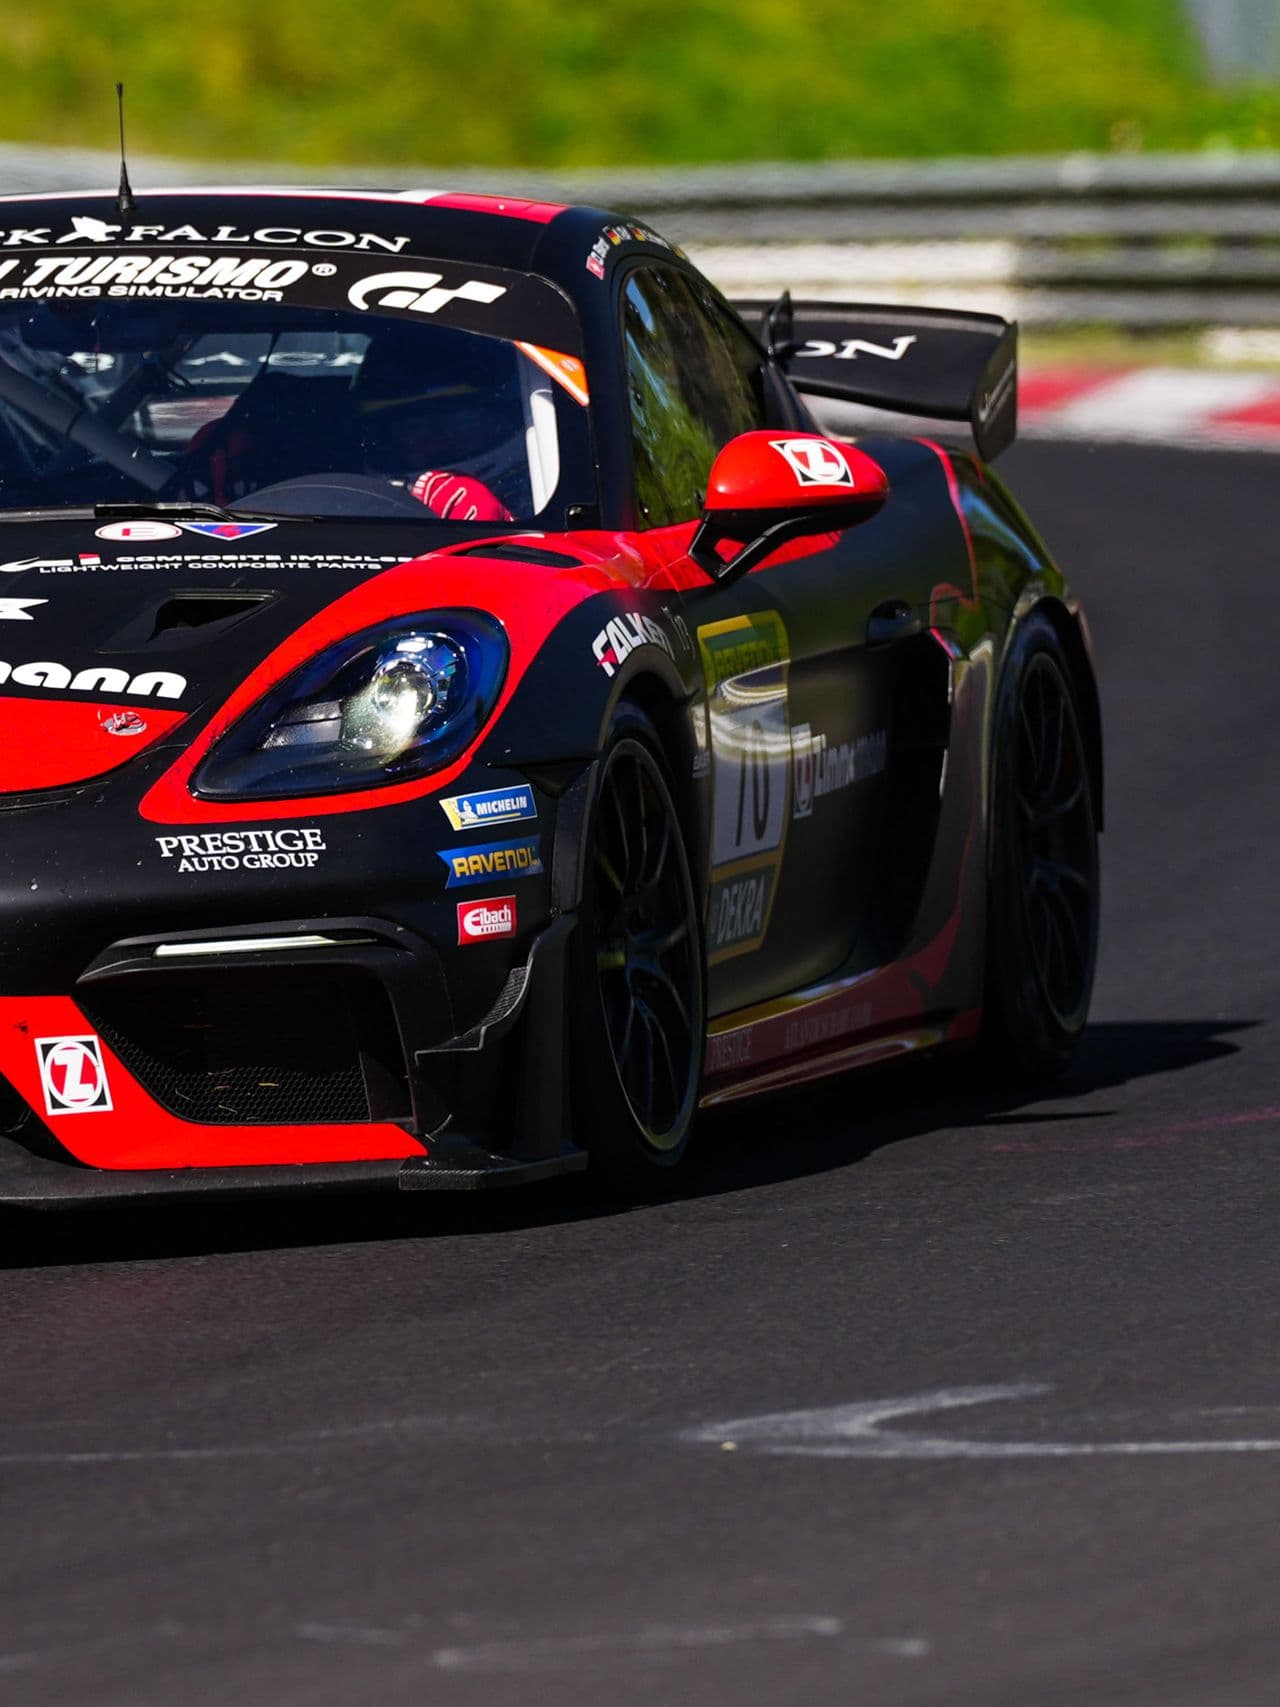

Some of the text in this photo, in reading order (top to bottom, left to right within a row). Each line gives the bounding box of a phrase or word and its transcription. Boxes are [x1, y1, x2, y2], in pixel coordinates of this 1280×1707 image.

[123, 224, 412, 253] FALCON
[107, 285, 284, 301] SIMULATOR
[39, 562, 382, 574] LIGHTWEIGHT COMPOSITE PARTS
[476, 796, 528, 816] MICHELIN
[155, 829, 326, 857] PRESTIGE
[178, 852, 319, 873] AUTO GROUP
[451, 847, 539, 878] RAVENOL
[463, 904, 512, 936] Eibach
